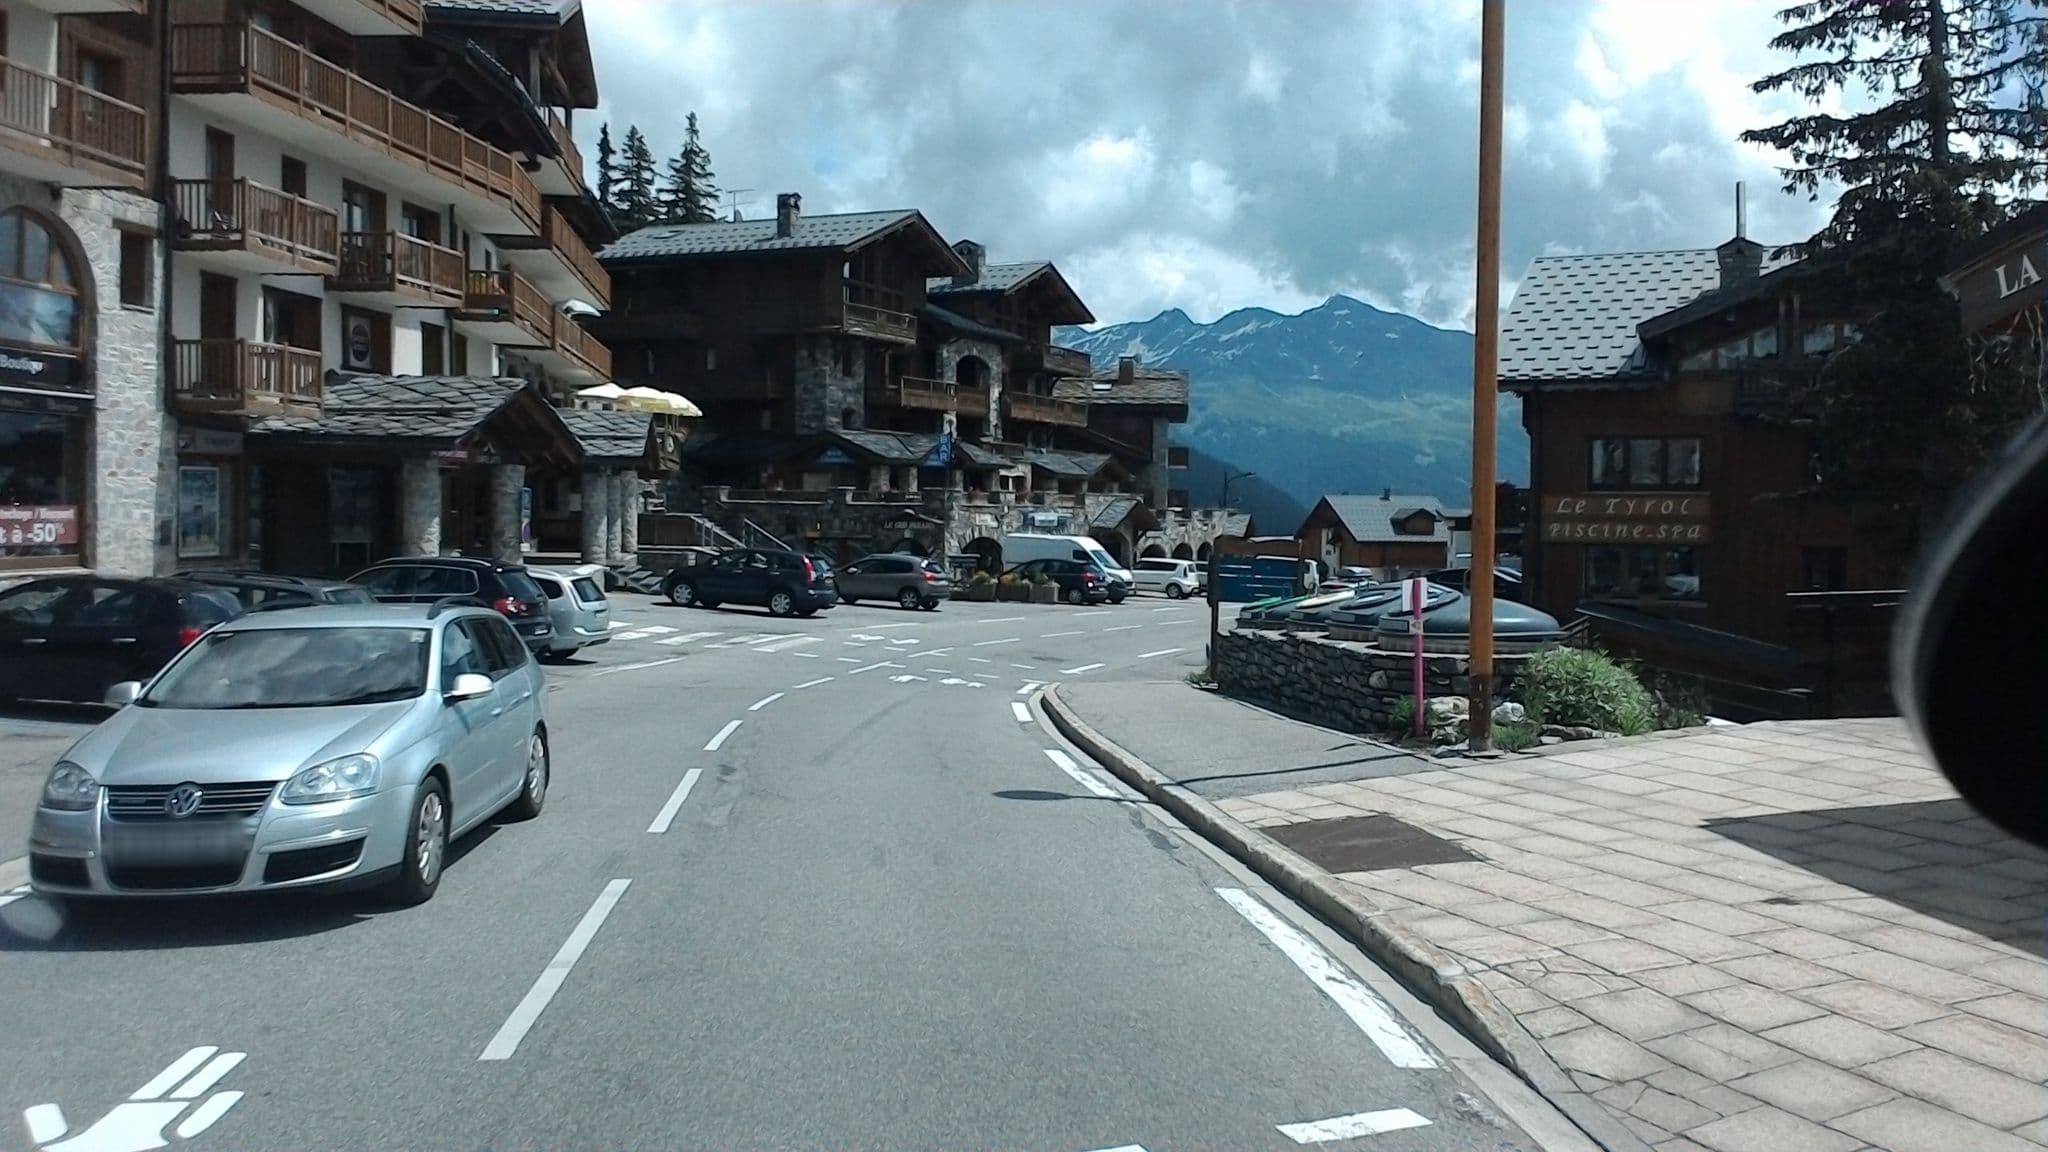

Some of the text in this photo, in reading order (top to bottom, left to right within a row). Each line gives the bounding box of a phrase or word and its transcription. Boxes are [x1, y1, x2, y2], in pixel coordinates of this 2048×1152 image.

[1995, 253, 2042, 299] LA
[939, 435, 949, 463] BAR
[1556, 497, 1691, 515] Le Tyrol
